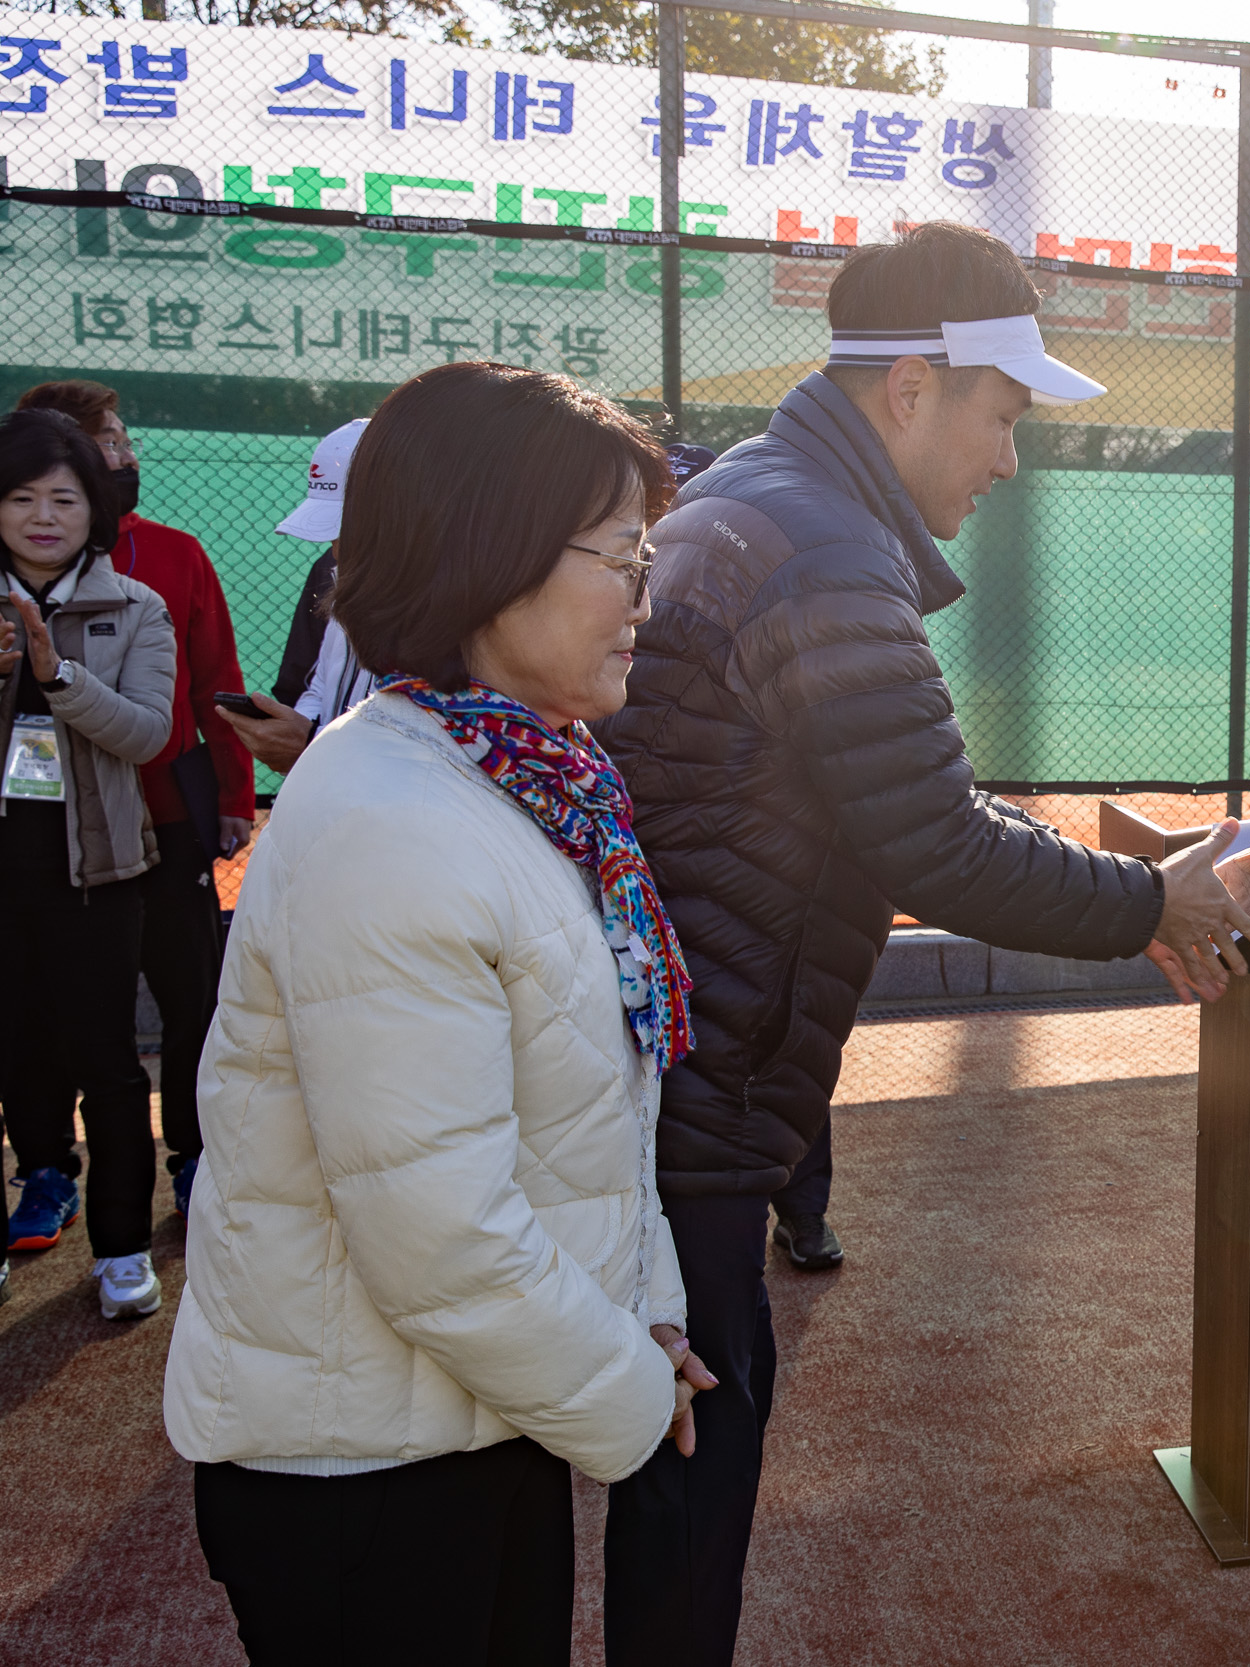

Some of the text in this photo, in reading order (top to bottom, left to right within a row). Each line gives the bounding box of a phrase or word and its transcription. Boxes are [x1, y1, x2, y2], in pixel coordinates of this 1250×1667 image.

[127, 194, 161, 210] KTA
[367, 216, 396, 229] KTA
[586, 229, 613, 242] KTA
[791, 244, 817, 257] KTA
